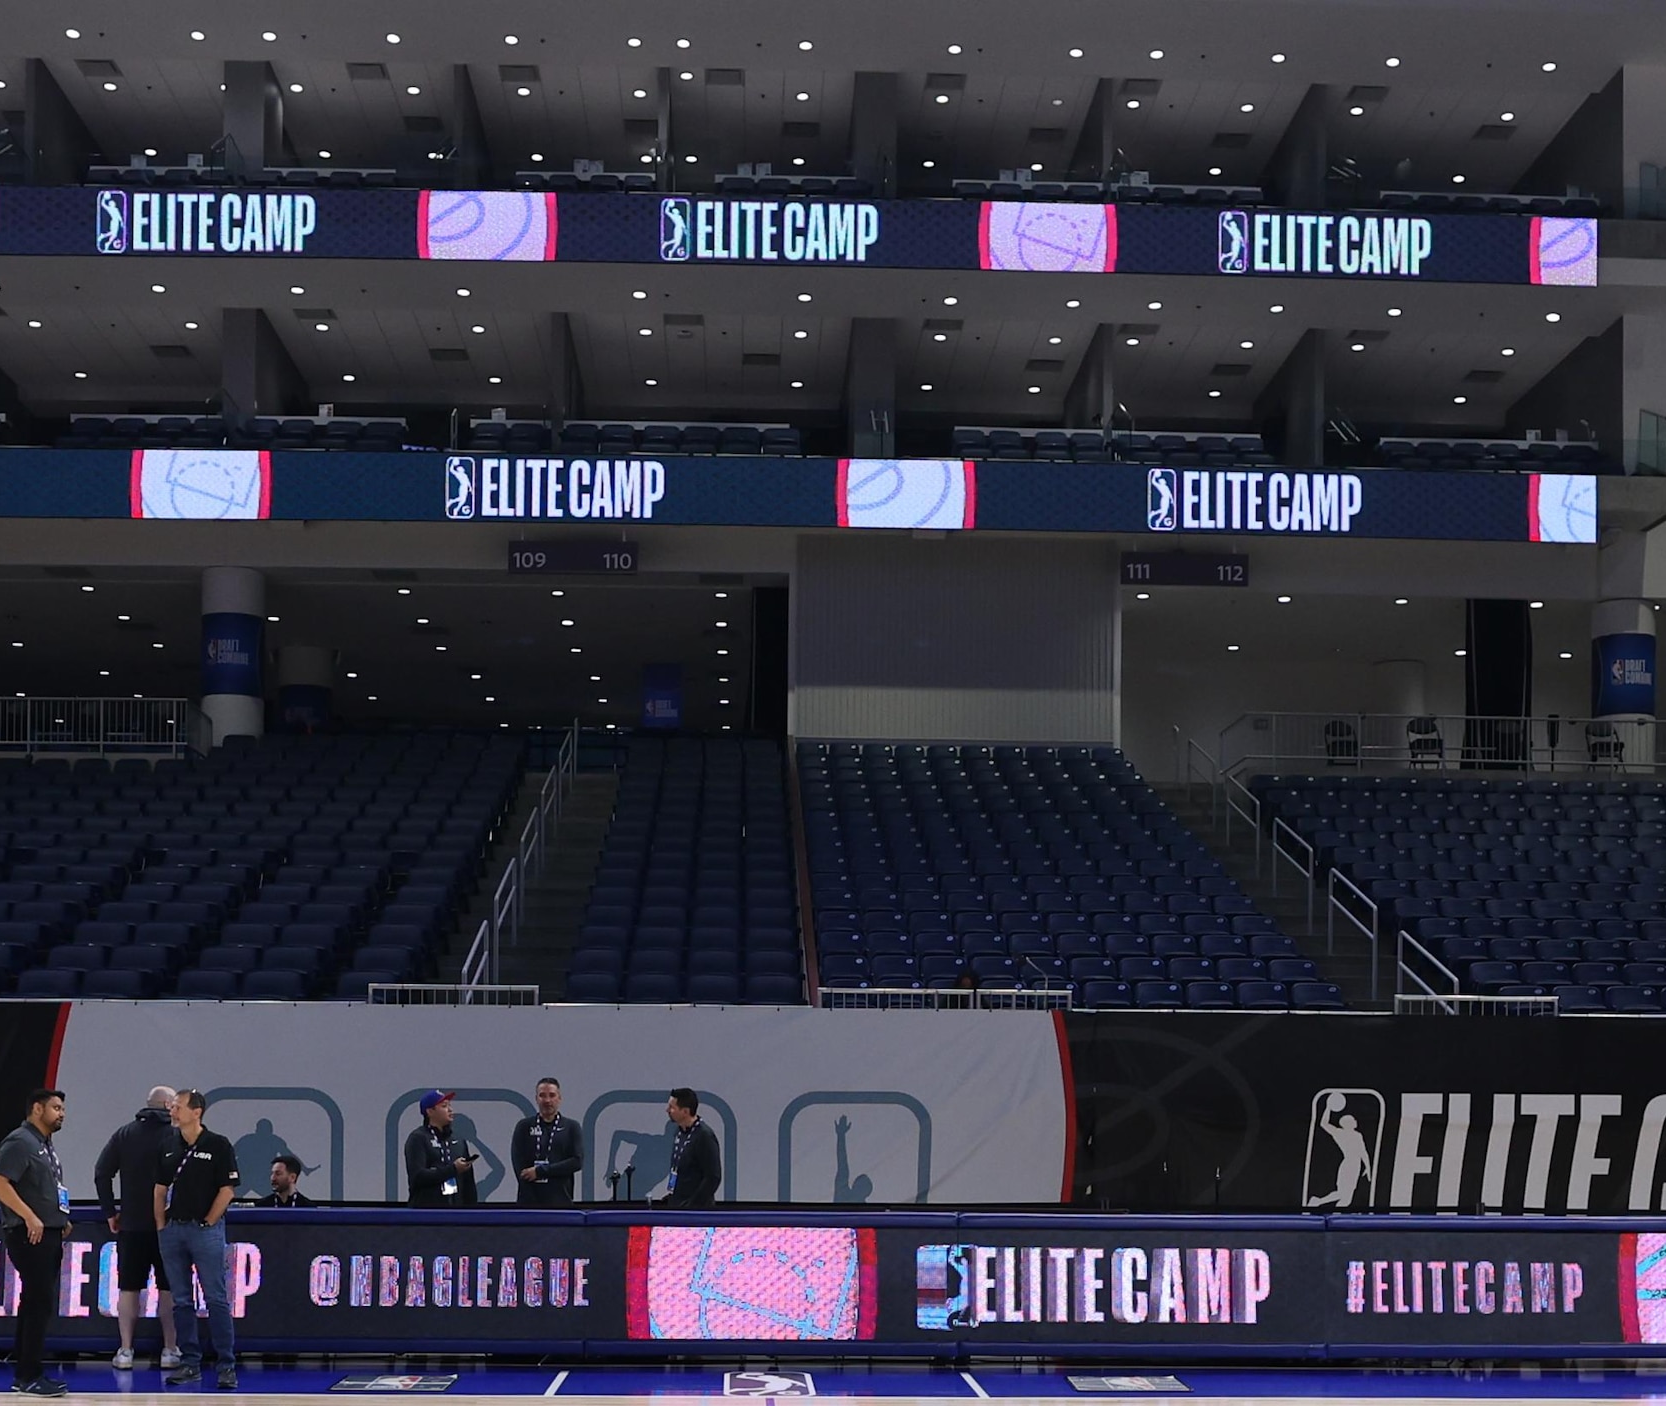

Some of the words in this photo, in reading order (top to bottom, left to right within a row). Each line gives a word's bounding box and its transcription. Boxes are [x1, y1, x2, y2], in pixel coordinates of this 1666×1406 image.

[132, 193, 214, 251] ELITE
[221, 193, 315, 251] CAMP
[696, 202, 778, 261] ELITE
[784, 202, 877, 261] CAMP
[1254, 214, 1333, 275] ELITE
[1340, 214, 1431, 275] CAMP
[481, 459, 563, 518] ELITE
[569, 459, 664, 518] CAMP
[1183, 471, 1263, 532] ELITE
[1269, 471, 1361, 532] CAMP
[513, 551, 546, 569] 109
[603, 553, 632, 570] 110
[1127, 563, 1150, 580] 111
[1217, 565, 1244, 582] 112
[309, 1255, 590, 1308] @NBAGLEAGUE
[1346, 1261, 1583, 1314] #ELITECAMP
